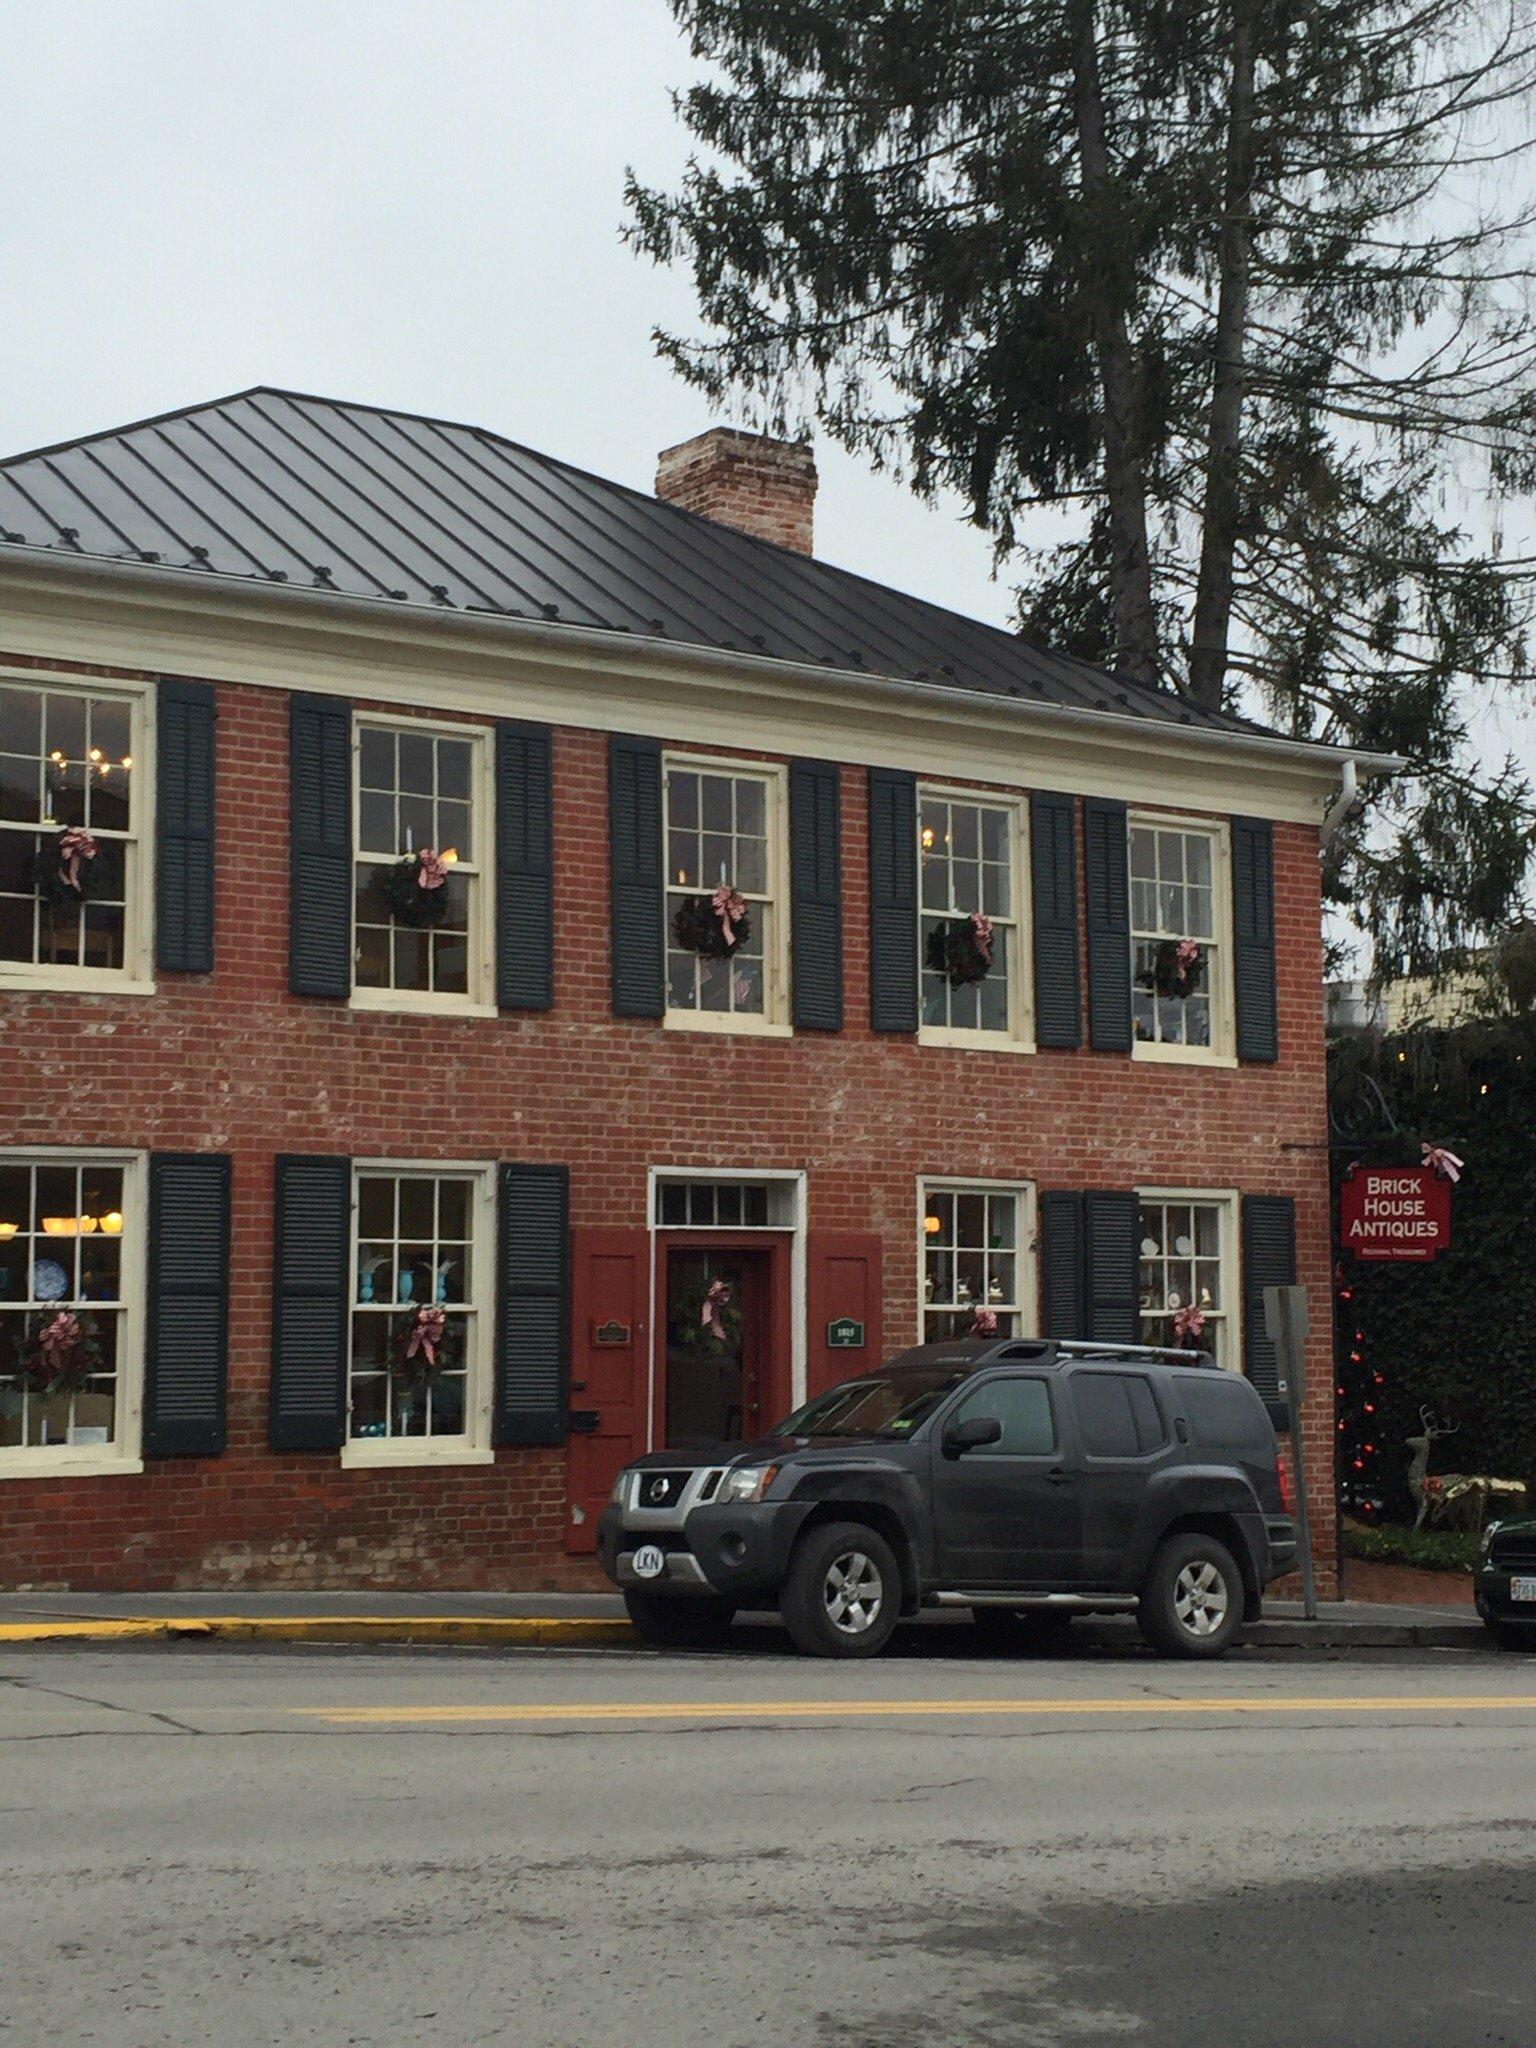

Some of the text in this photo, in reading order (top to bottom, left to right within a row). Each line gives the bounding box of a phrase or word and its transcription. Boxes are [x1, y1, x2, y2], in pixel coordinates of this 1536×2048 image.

[1367, 1177, 1421, 1194] BRICK
[1364, 1199, 1425, 1216] HOUSE
[1349, 1219, 1439, 1238] ANTIQUES
